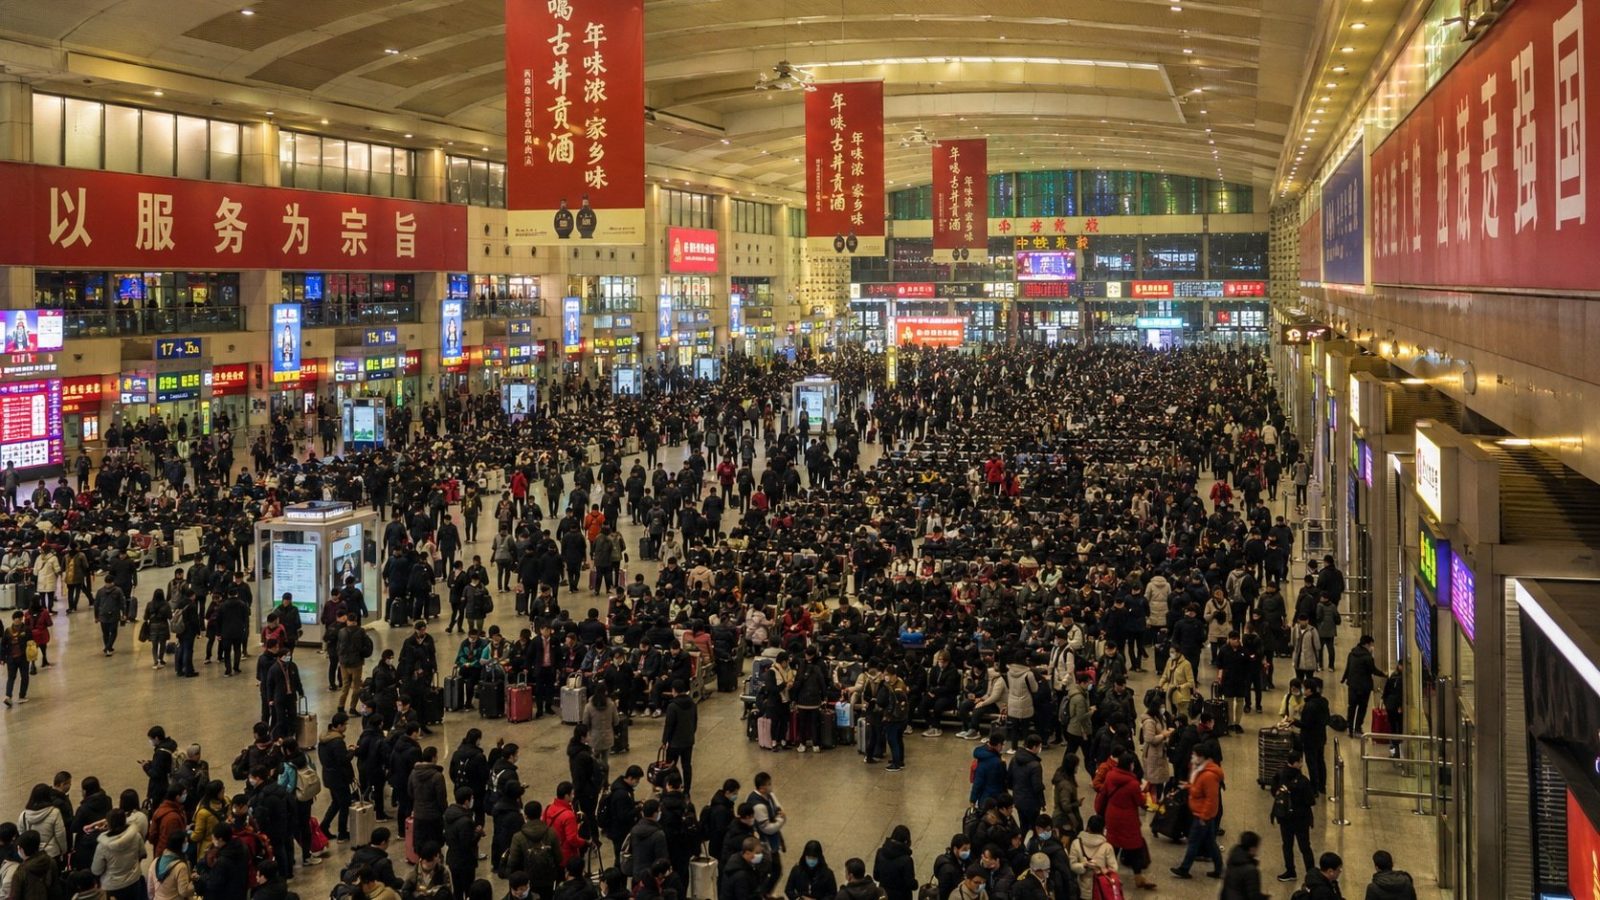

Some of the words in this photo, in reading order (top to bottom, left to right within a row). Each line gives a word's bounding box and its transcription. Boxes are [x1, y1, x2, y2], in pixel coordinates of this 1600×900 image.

[48, 187, 418, 258] 以服务为宗旨
